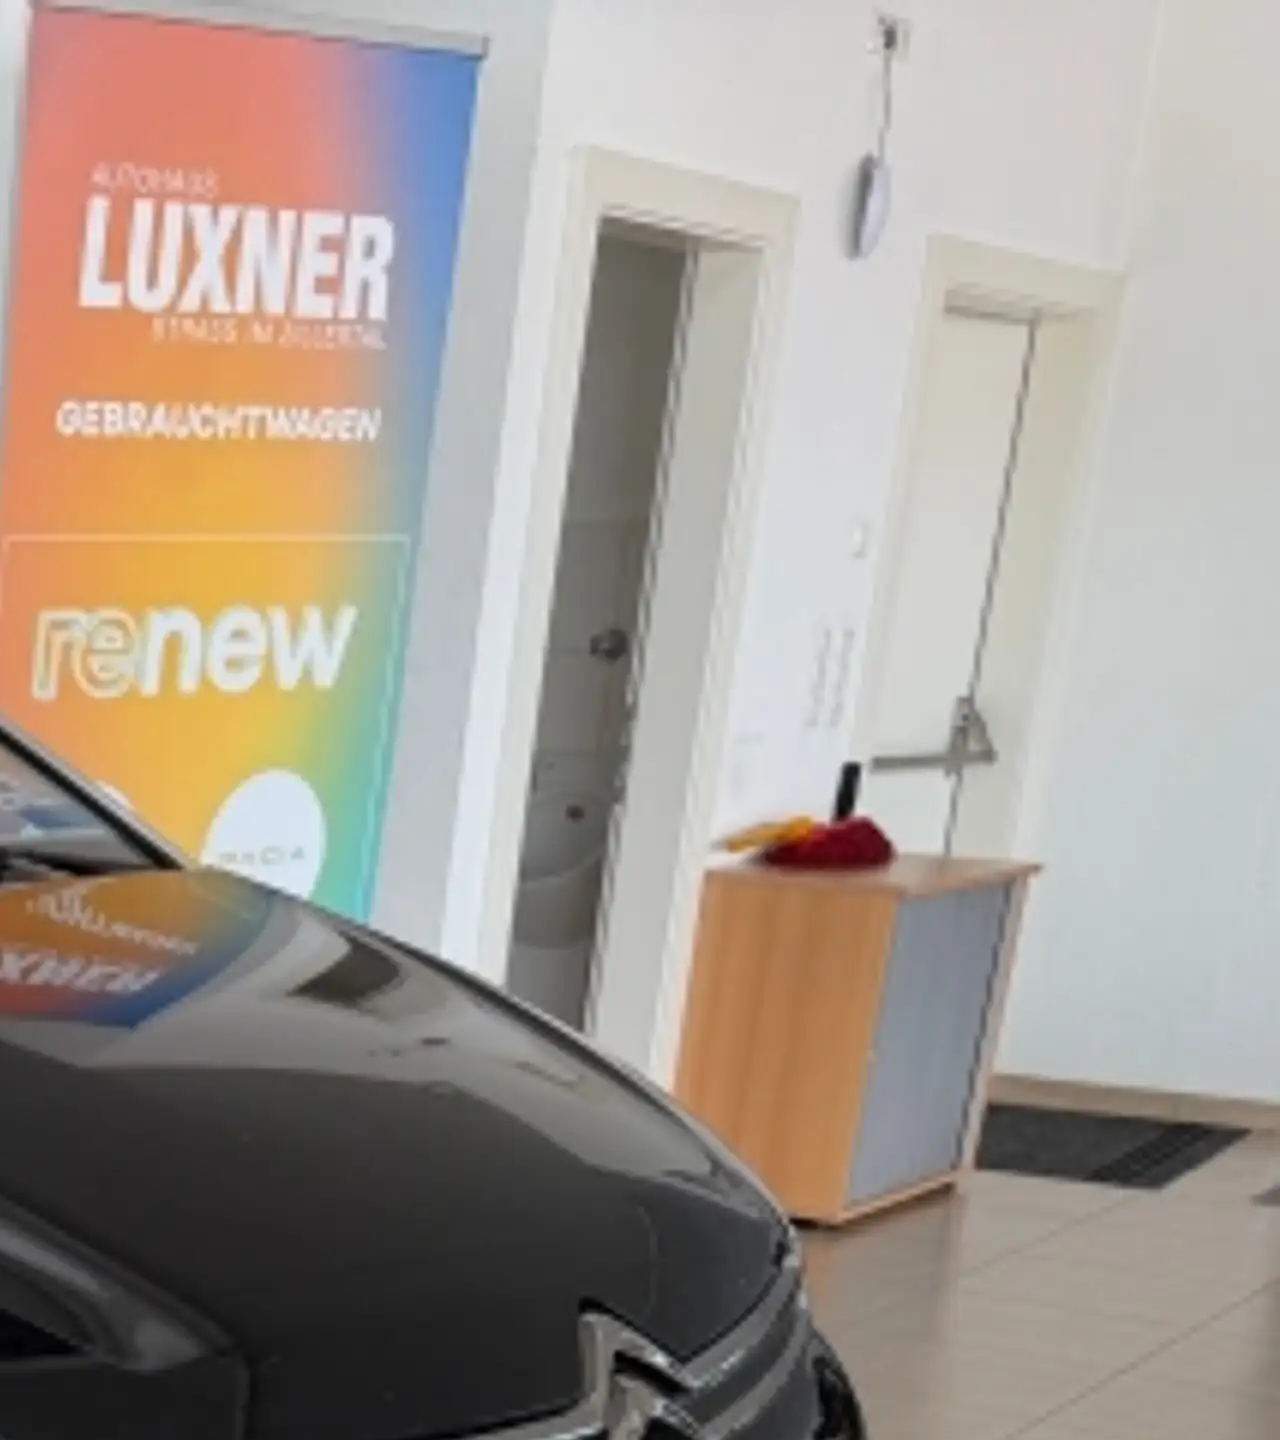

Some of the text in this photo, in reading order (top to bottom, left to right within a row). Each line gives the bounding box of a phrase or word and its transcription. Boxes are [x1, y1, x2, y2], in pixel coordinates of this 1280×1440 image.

[78, 194, 395, 320] LUXNER
[55, 400, 382, 441] GEBRAUCHTWAGEN
[30, 604, 358, 701] renew
